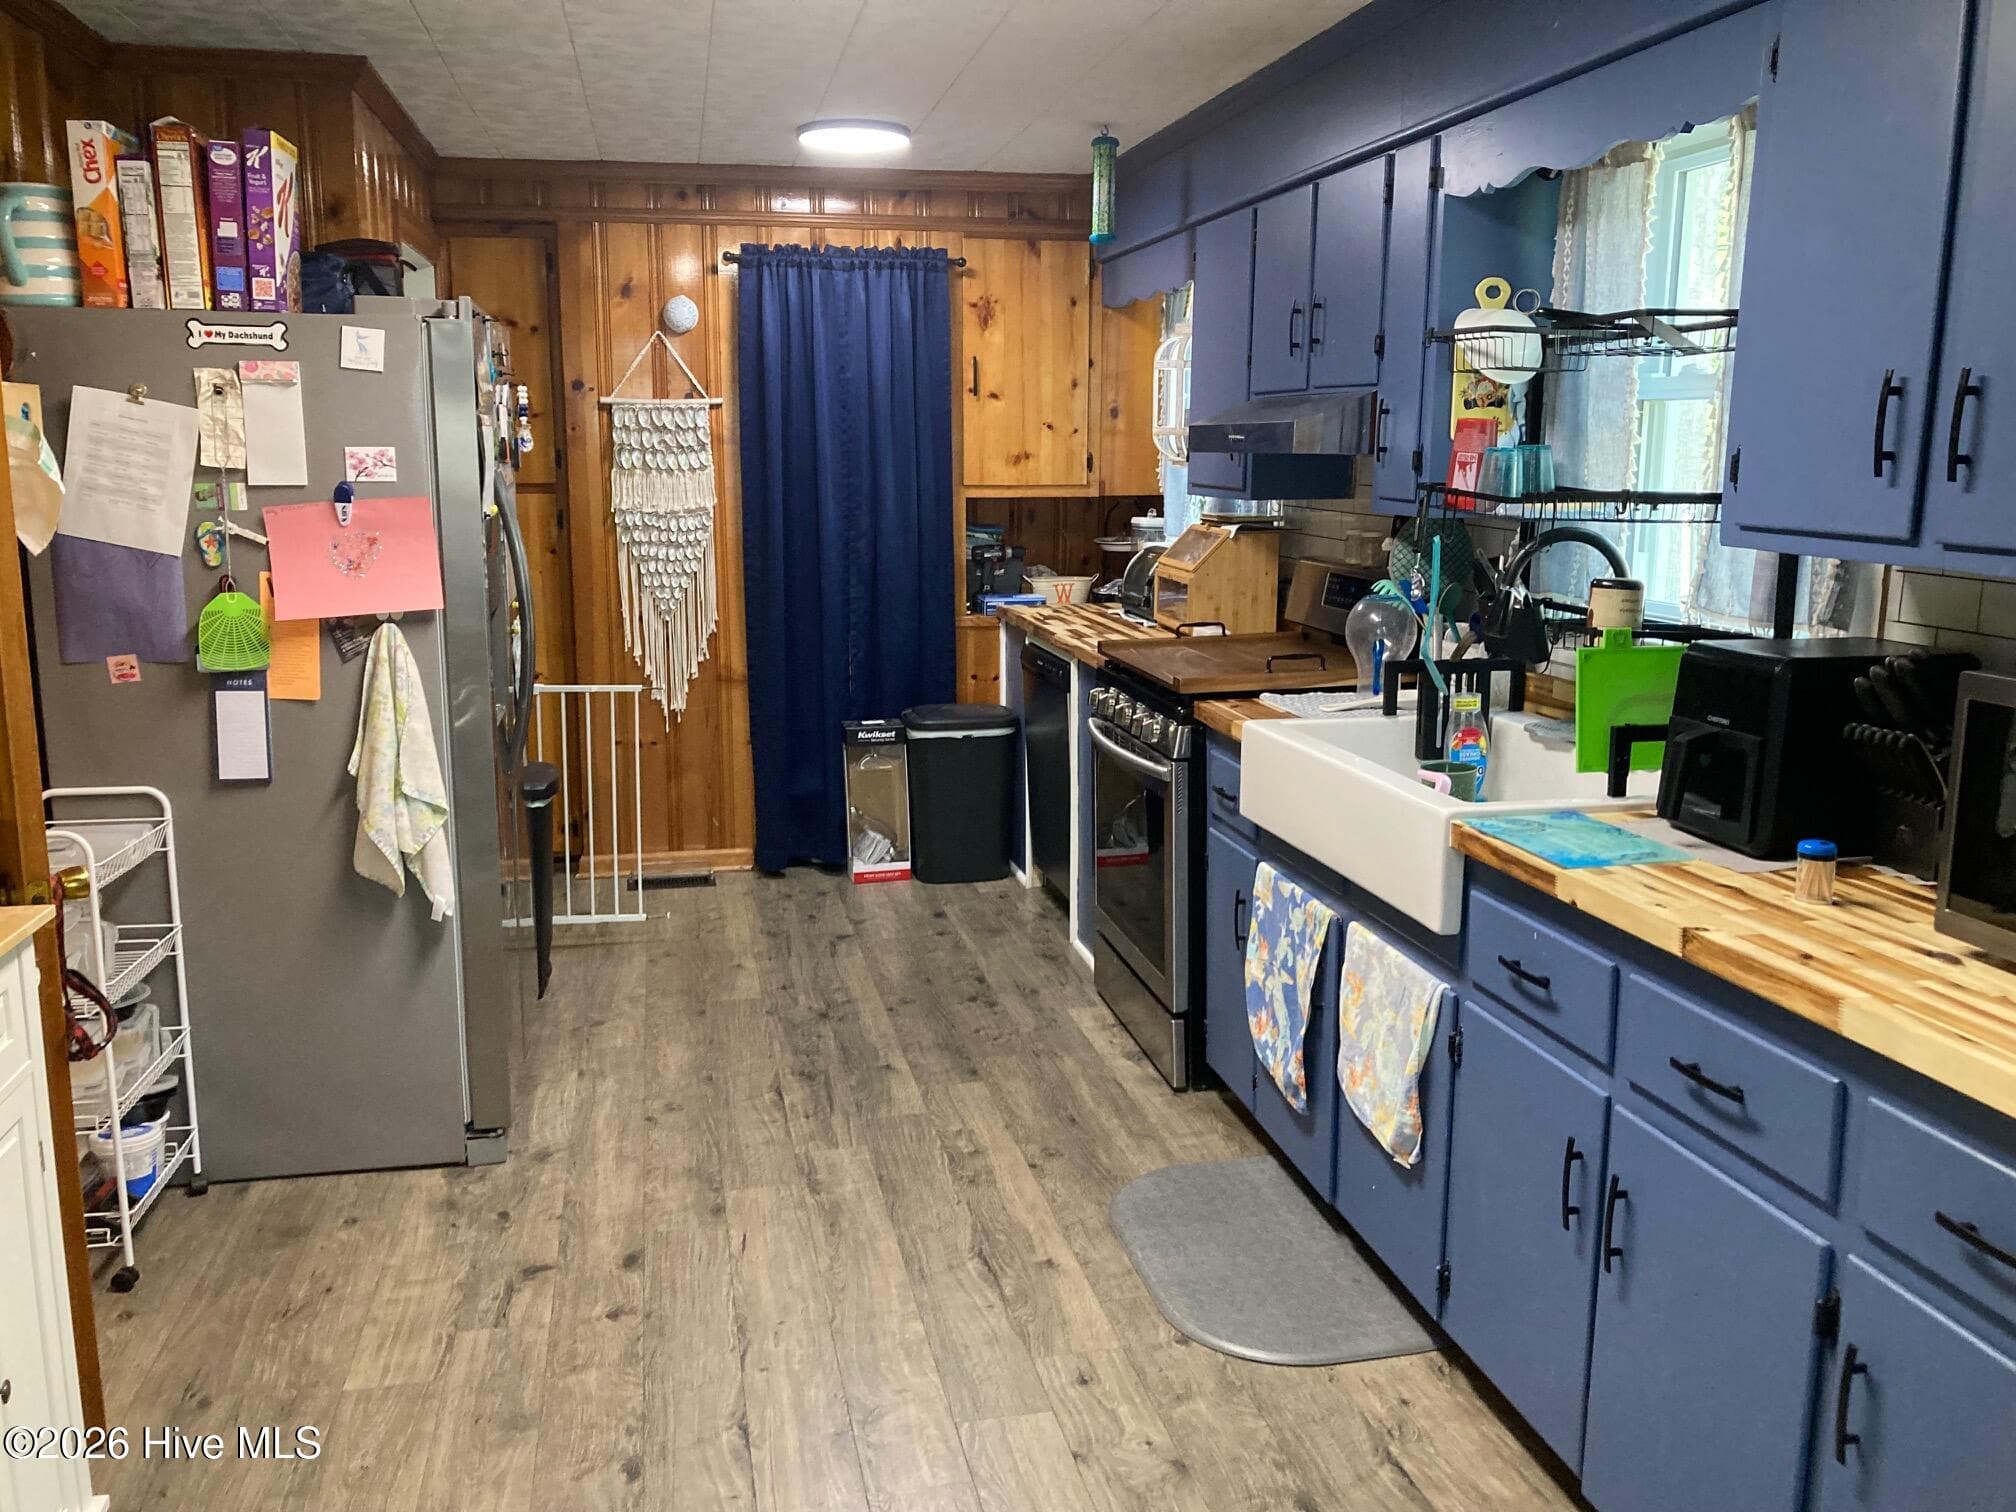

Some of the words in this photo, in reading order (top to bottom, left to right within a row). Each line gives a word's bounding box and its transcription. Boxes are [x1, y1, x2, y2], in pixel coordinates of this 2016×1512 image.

[81, 138, 101, 183] Chex
[214, 331, 226, 340] My
[228, 331, 273, 340] Dachshund
[1053, 583, 1074, 604] W
[857, 730, 896, 739] Kwikset
